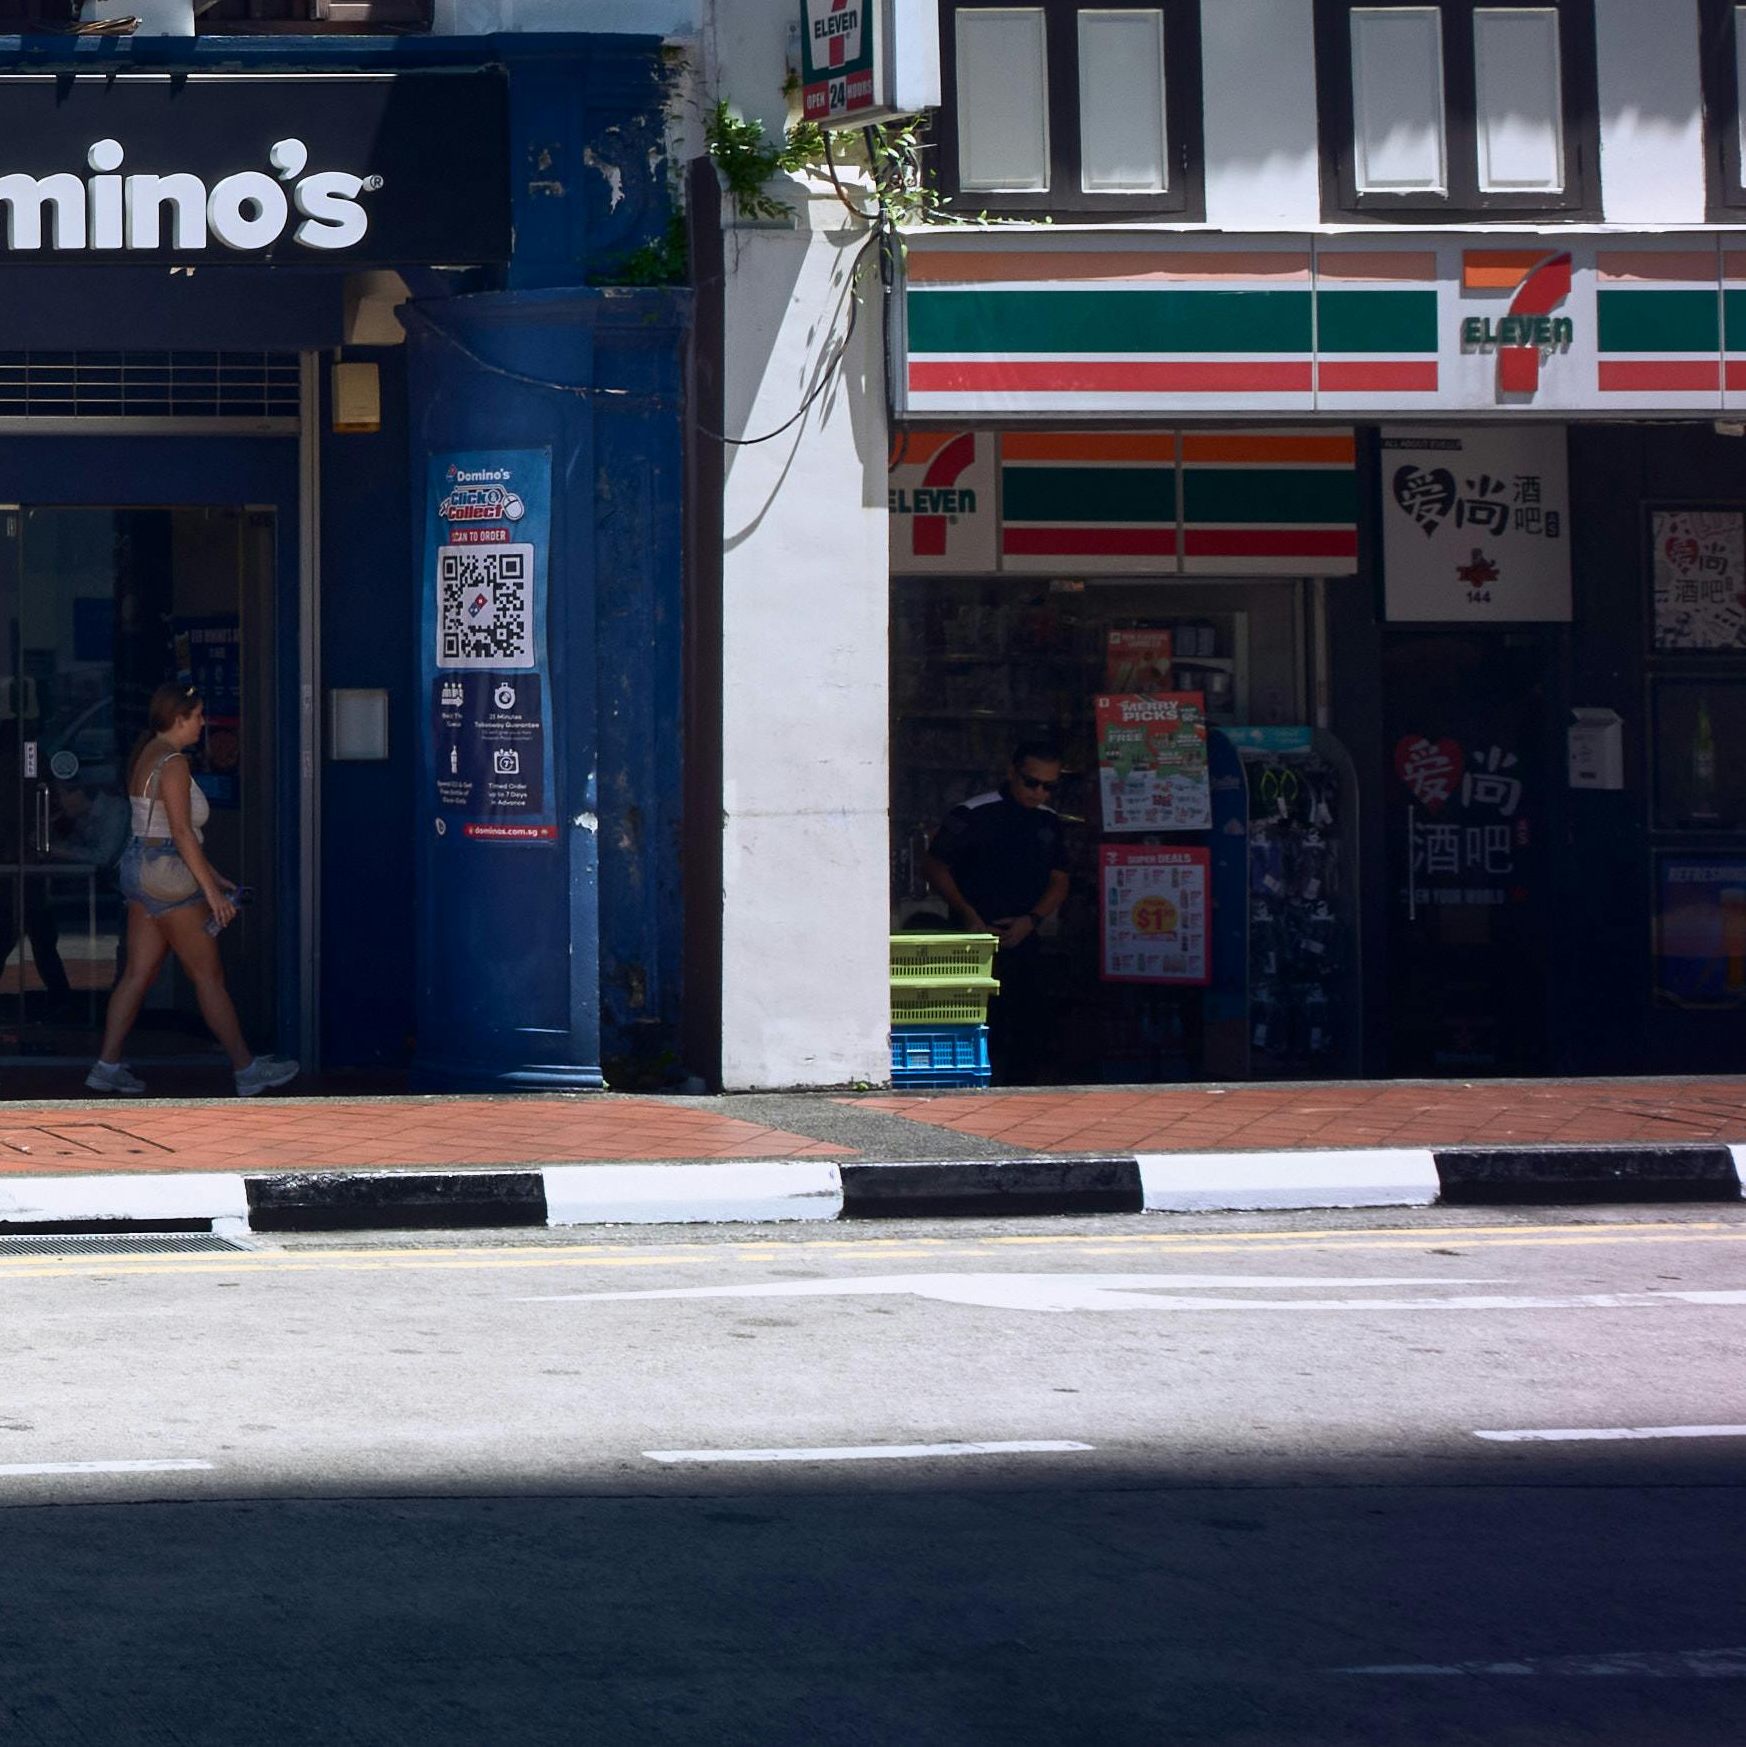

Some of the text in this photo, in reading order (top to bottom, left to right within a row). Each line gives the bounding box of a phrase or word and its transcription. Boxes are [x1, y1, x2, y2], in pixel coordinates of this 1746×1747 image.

[806, 78, 873, 108] OPEN 24 HOURS
[457, 467, 511, 482] Domino's
[451, 490, 487, 505] Click
[448, 504, 503, 520] Collect
[469, 532, 478, 542] TO
[479, 530, 506, 542] ORDER
[1466, 590, 1492, 603] 144
[1122, 700, 1179, 712] MERRY
[1122, 710, 1179, 722] PICKS
[508, 782, 527, 790] Order
[474, 827, 539, 837] dominos.com.sg
[1157, 853, 1192, 863] DEALS
